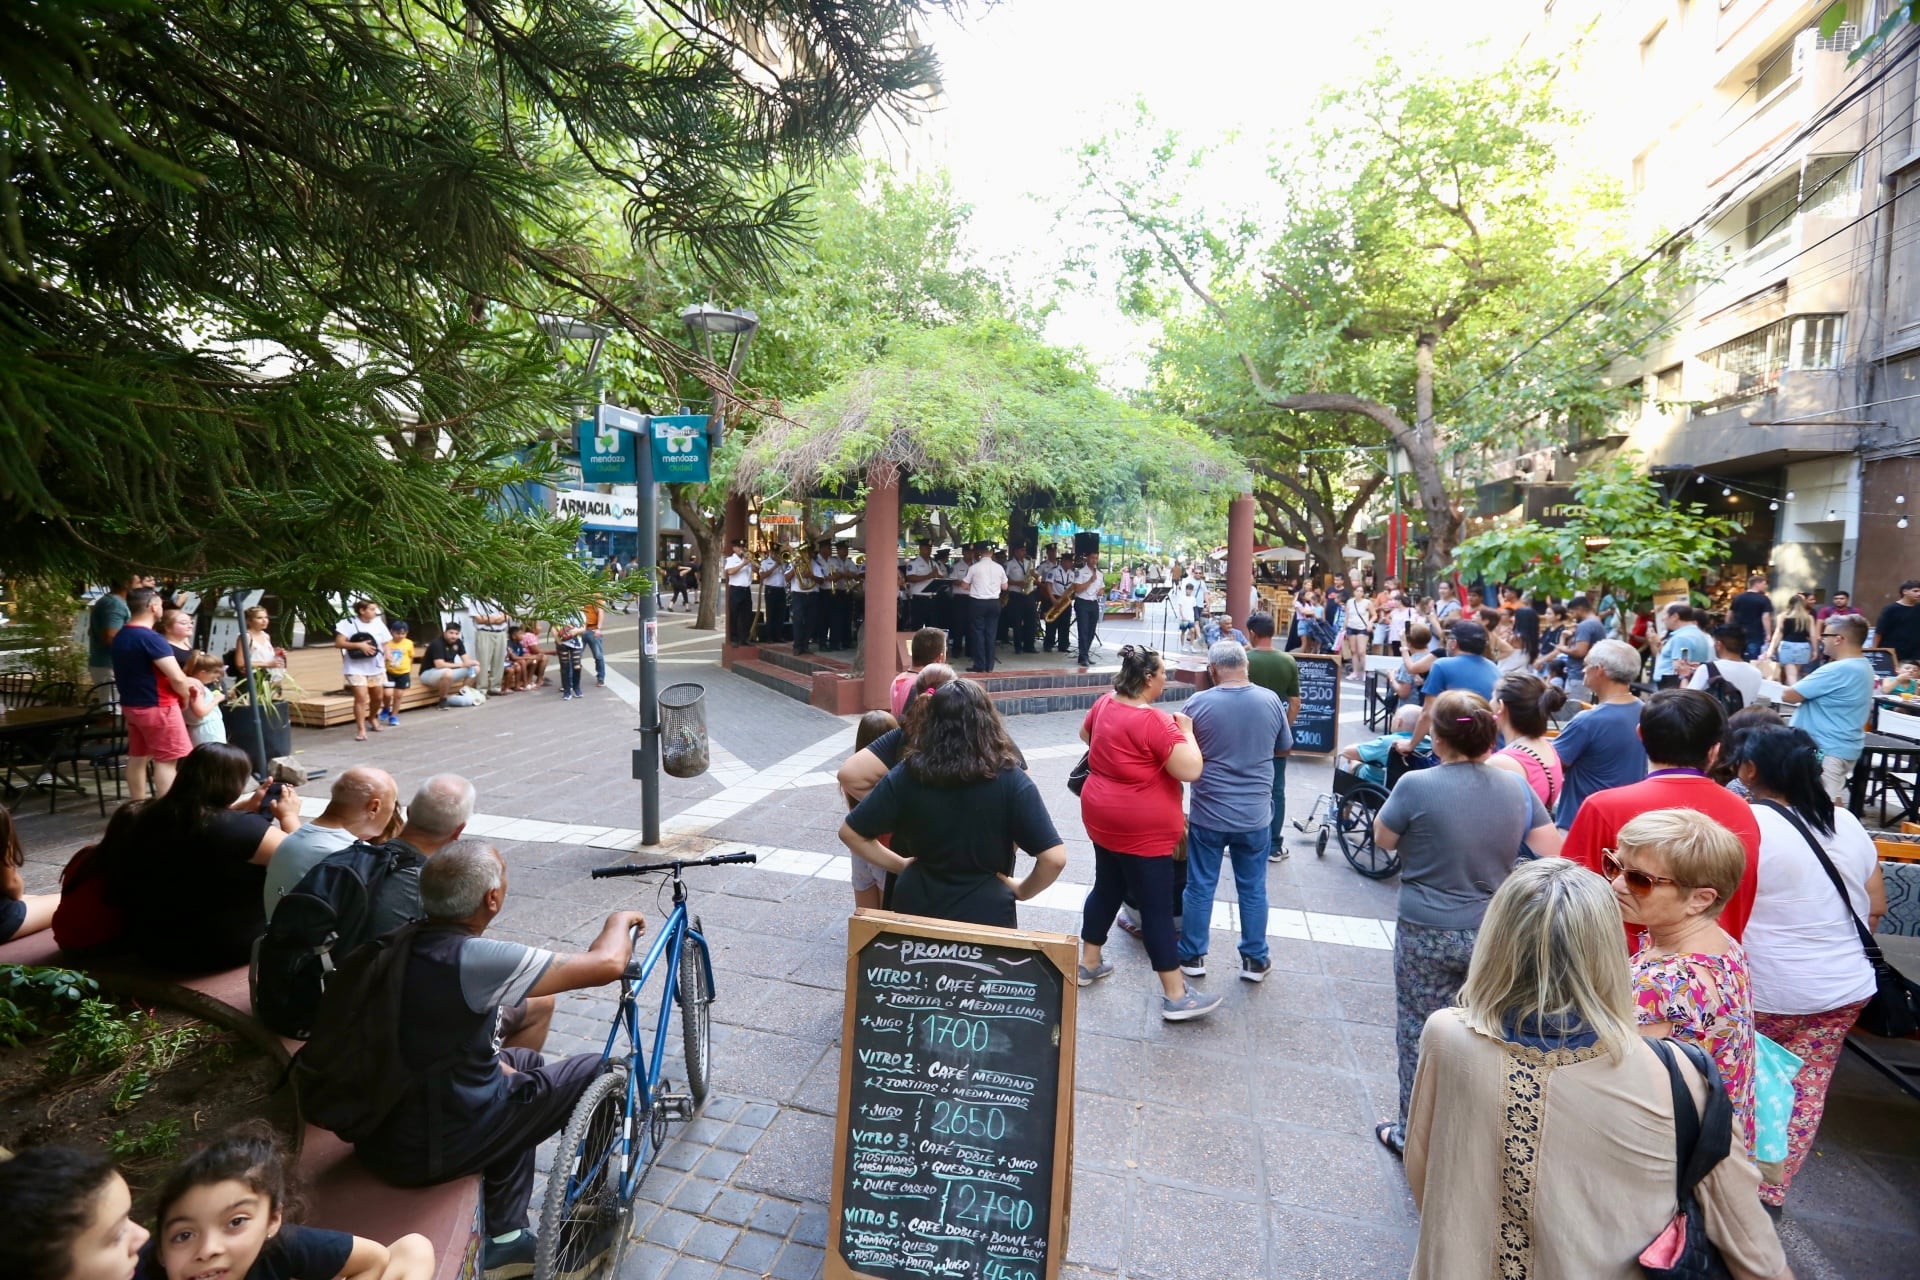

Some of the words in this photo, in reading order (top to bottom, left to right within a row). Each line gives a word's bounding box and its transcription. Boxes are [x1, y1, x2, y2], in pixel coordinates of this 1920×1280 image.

[591, 455, 626, 464] mendoza
[662, 454, 699, 463] mendoza
[1299, 685, 1333, 700] 5500
[1296, 730, 1322, 745] 3100
[901, 940, 983, 962] PROMOS
[867, 967, 911, 984] VITRO
[936, 973, 977, 993] CAFÉ
[979, 984, 1037, 997] MEDIANO
[890, 992, 941, 1006] TORTITA
[959, 999, 1046, 1020] MEDIALUNA
[871, 1016, 903, 1028] JUGO
[922, 1014, 989, 1051] 1700
[859, 1049, 901, 1065] VITRO
[928, 1062, 970, 1080] CAFÉ
[972, 1072, 1034, 1091] MEDIANO
[885, 1077, 938, 1092] TORTITAS
[953, 1087, 1030, 1107] MEDIALUNAS
[870, 1104, 903, 1117] JUGO
[931, 1101, 1005, 1139] 2650
[852, 1129, 894, 1145] VITRO
[919, 1140, 955, 1155] CAFÉ
[956, 1150, 993, 1163] DOBLE
[1008, 1157, 1038, 1170] JUGO
[931, 1161, 973, 1176] QUESO
[977, 1169, 1021, 1184] CREMA
[863, 1178, 899, 1191] DULCE
[957, 1184, 1033, 1230] 2790
[845, 1207, 885, 1225] VITRO
[945, 1224, 980, 1238] DOBLE
[989, 1231, 1030, 1246] BOWL
[902, 1240, 938, 1253] QUESO
[1022, 1248, 1045, 1259] REV.
[941, 1257, 970, 1271] JUGO
